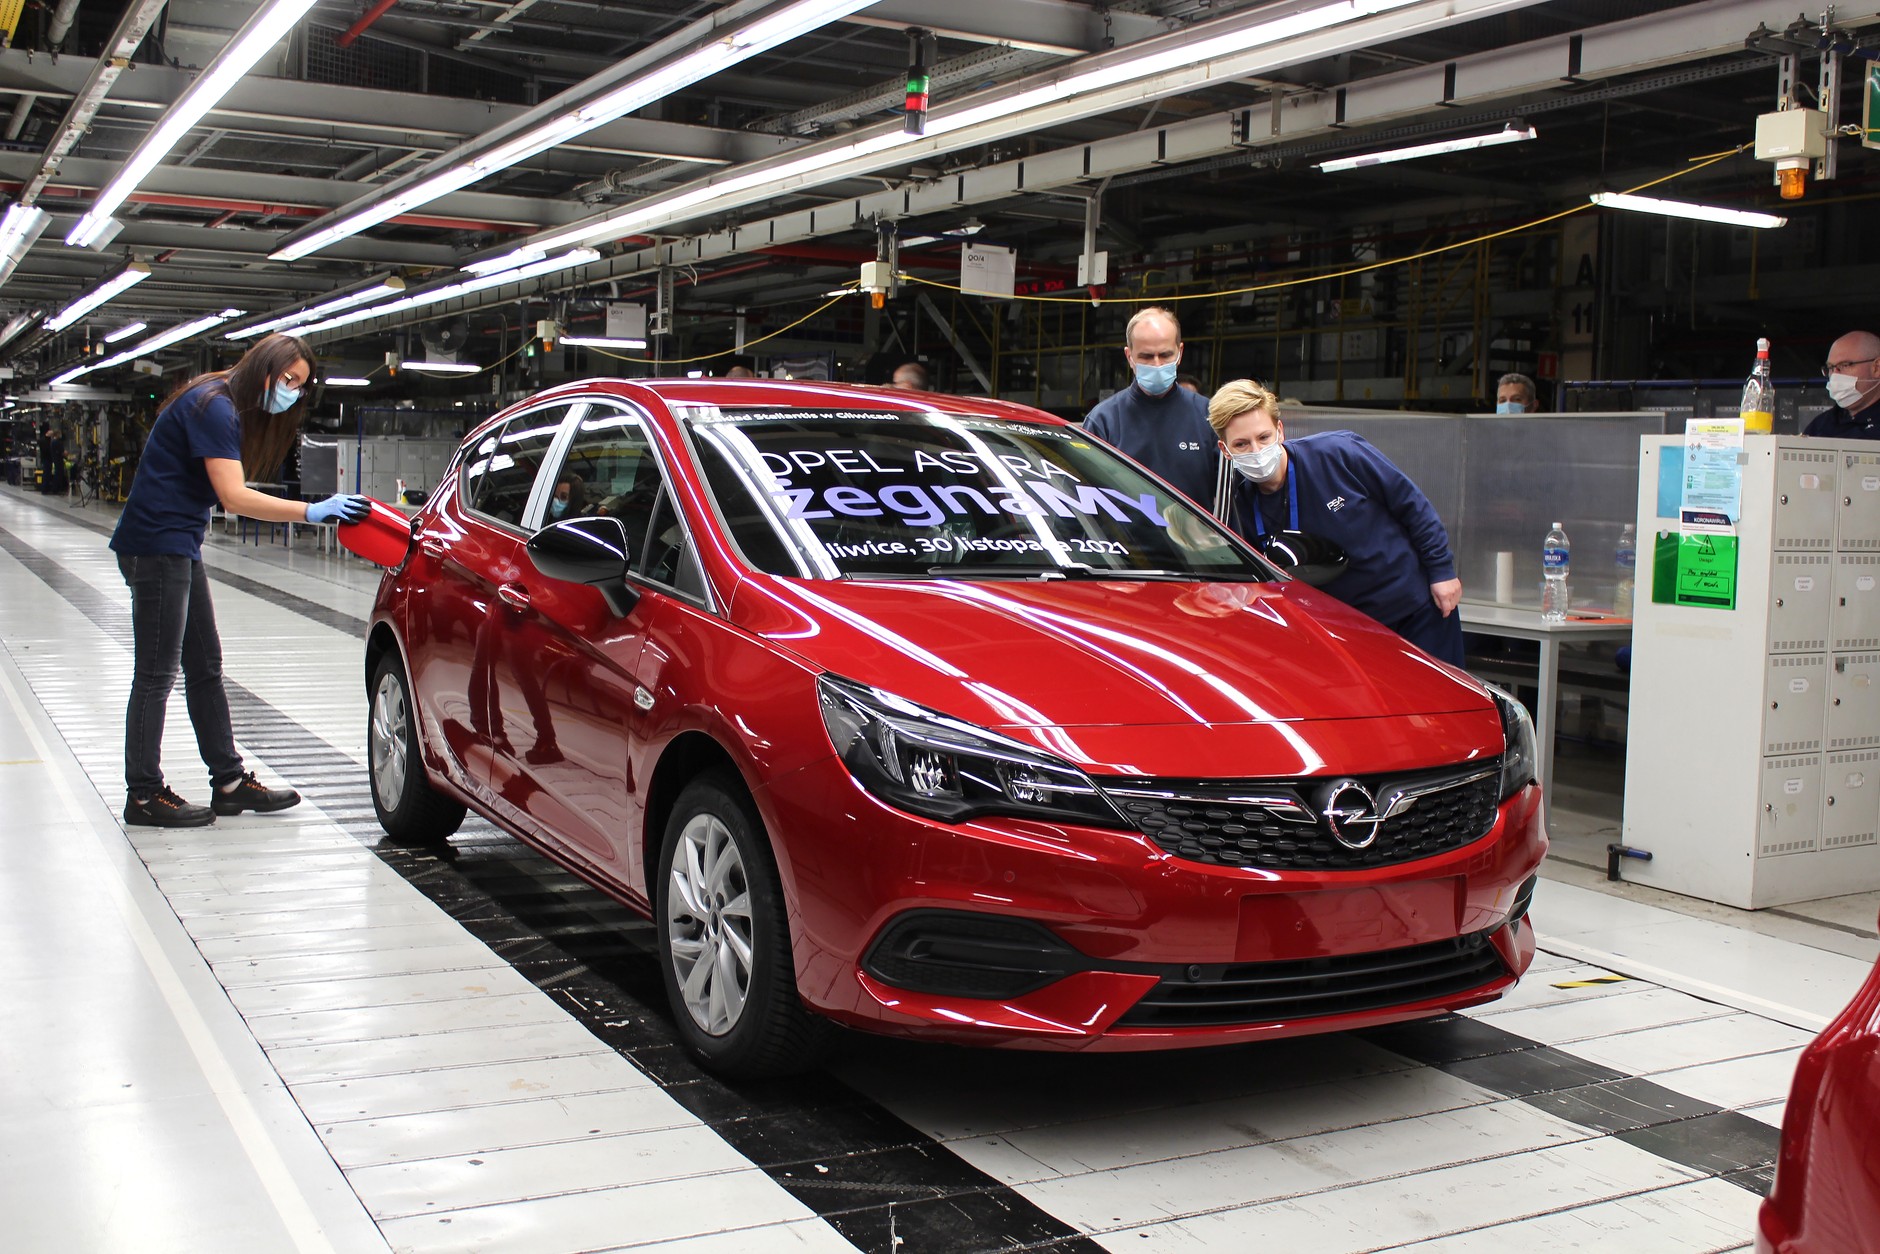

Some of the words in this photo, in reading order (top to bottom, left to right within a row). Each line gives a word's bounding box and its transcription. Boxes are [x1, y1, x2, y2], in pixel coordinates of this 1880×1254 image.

[1576, 254, 1594, 286] A
[759, 450, 904, 476] OPEL
[770, 478, 1171, 527] żegnaMY
[1326, 496, 1345, 510] PSA
[818, 539, 916, 559] liwice,
[915, 537, 953, 552] 30
[954, 536, 1069, 553] listopaa
[1070, 538, 1129, 555] 2021
